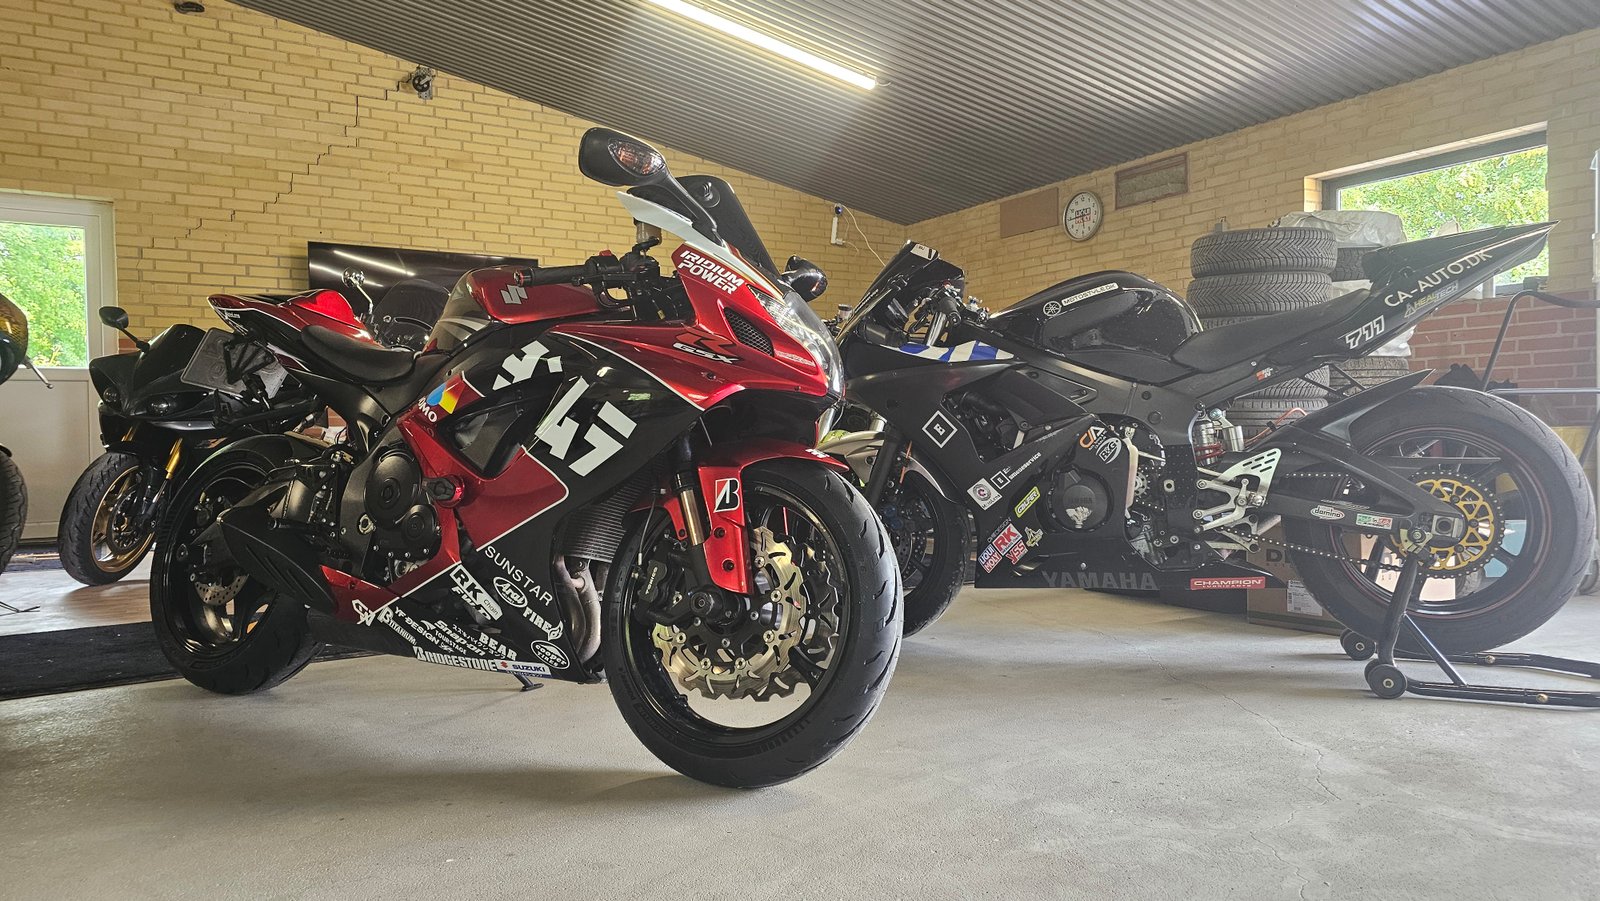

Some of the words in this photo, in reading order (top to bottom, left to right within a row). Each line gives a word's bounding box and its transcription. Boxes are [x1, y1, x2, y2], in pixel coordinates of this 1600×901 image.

[677, 259, 737, 295] POWER
[679, 250, 744, 287] IRIDIUM
[1384, 250, 1492, 308] CA-AUTO.DK
[1413, 279, 1459, 310] HEALTECH
[1345, 314, 1385, 350] 711
[1314, 507, 1341, 518] domino
[993, 527, 1018, 552] RK
[1005, 541, 1026, 565] YSS
[979, 545, 996, 565] LIQUI
[983, 551, 1001, 571] MOLY
[453, 568, 484, 605] RK
[484, 545, 553, 606] SUNSTAR
[1041, 570, 1160, 590] YAMAHA
[1193, 578, 1263, 587] CHAMPION
[495, 582, 525, 604] Arai
[522, 606, 553, 634] FIRE
[412, 645, 498, 672] BRIDGESTONE
[479, 632, 518, 661] BEAR
[512, 664, 546, 673] SUZUKI
